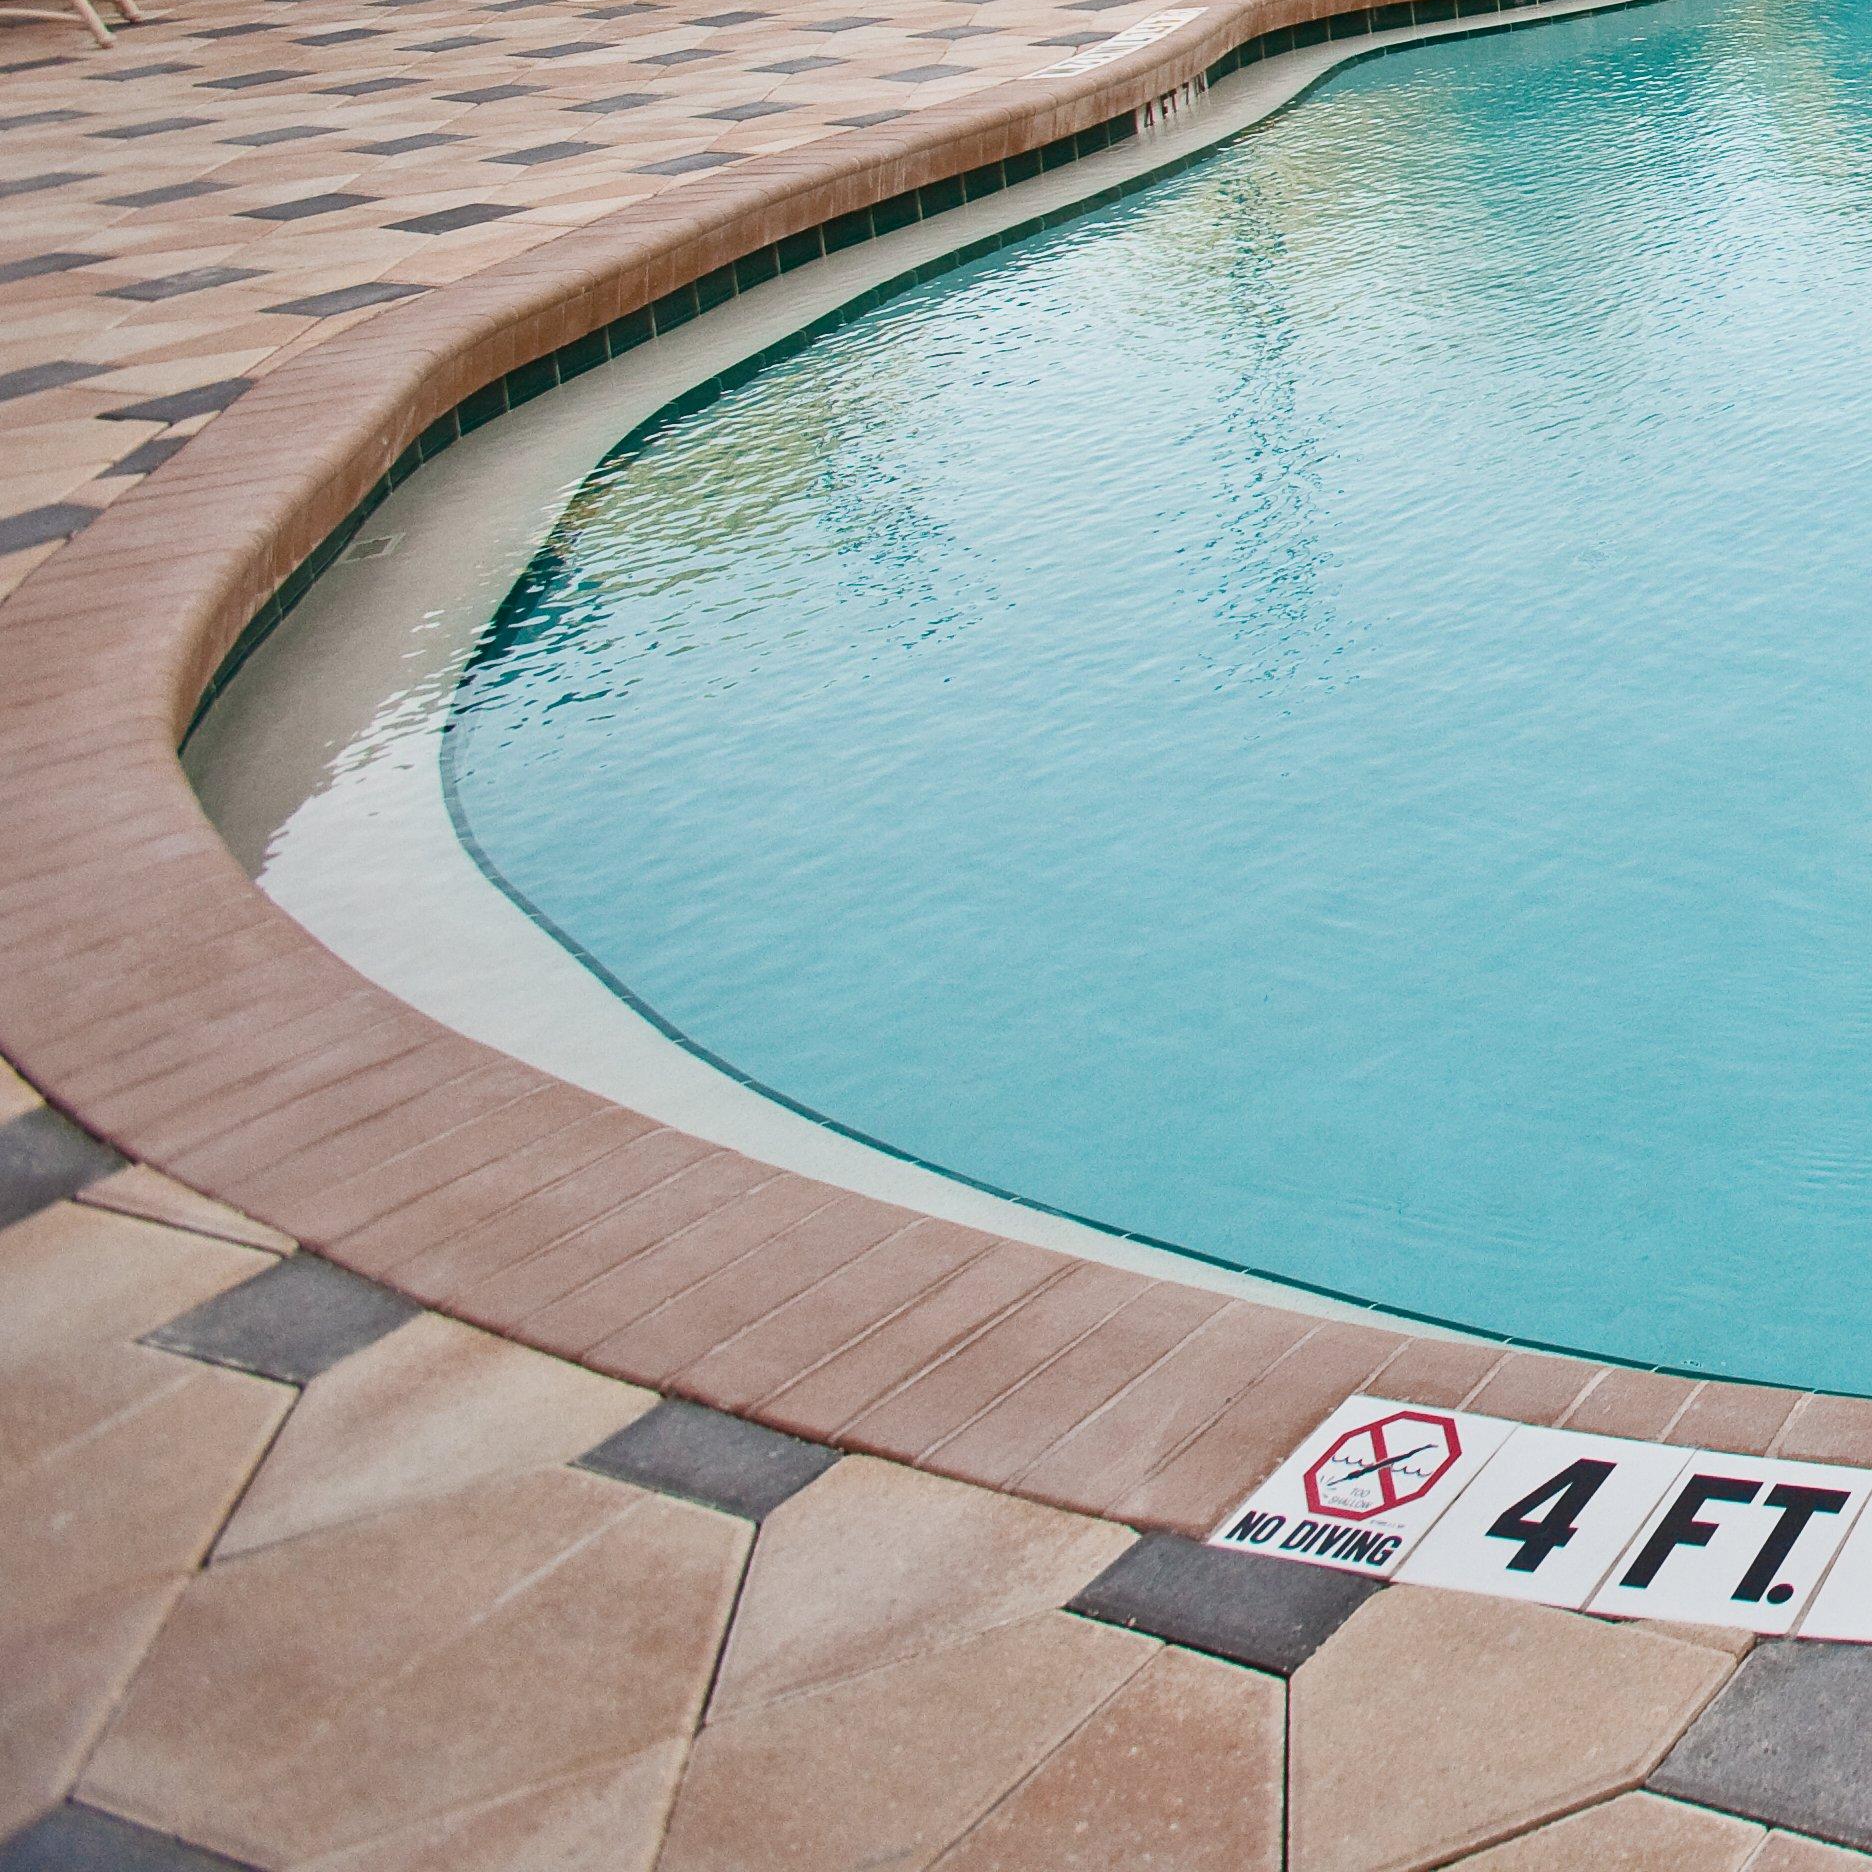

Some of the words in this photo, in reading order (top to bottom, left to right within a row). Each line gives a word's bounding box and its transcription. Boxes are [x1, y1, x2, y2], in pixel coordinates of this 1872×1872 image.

[1144, 100, 1155, 128] 4
[1160, 88, 1177, 119] FT
[1181, 81, 1190, 105] 7
[1327, 1495, 1374, 1509] SHALLOW
[1350, 1487, 1371, 1498] TOO
[1224, 1510, 1288, 1544] NO
[1278, 1519, 1403, 1566] DIVING
[1484, 1458, 1618, 1573] 4
[1619, 1473, 1852, 1606] FT.
